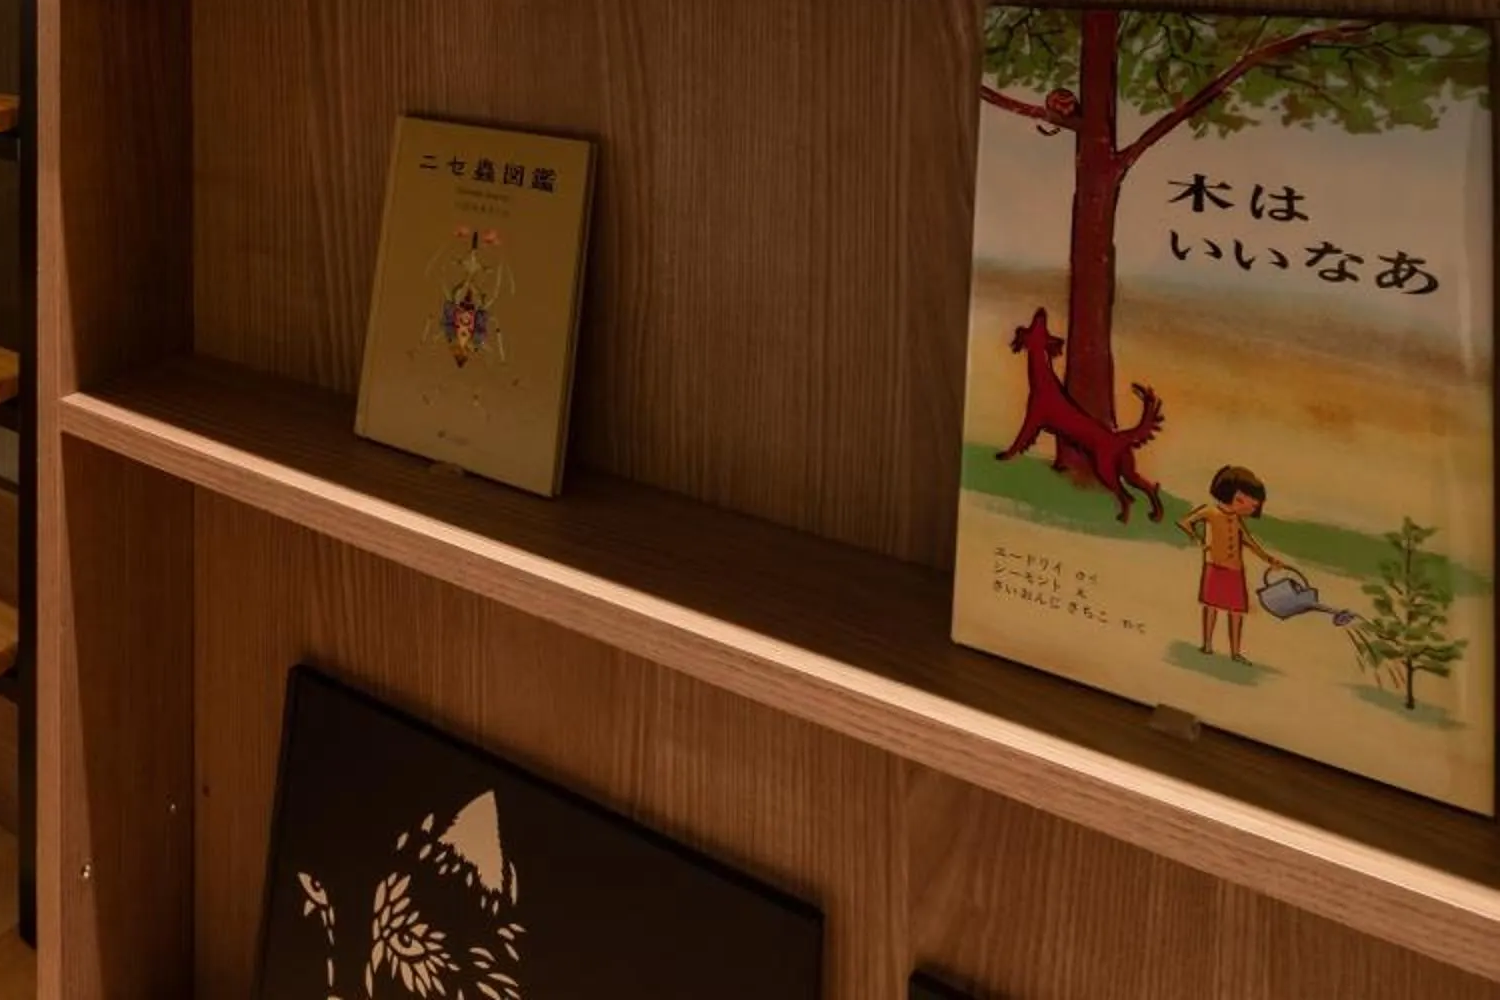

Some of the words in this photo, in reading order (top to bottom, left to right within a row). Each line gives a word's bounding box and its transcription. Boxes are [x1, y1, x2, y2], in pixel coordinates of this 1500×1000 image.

[1167, 173, 1309, 222] 木は
[1169, 229, 1439, 295] いいなあ
